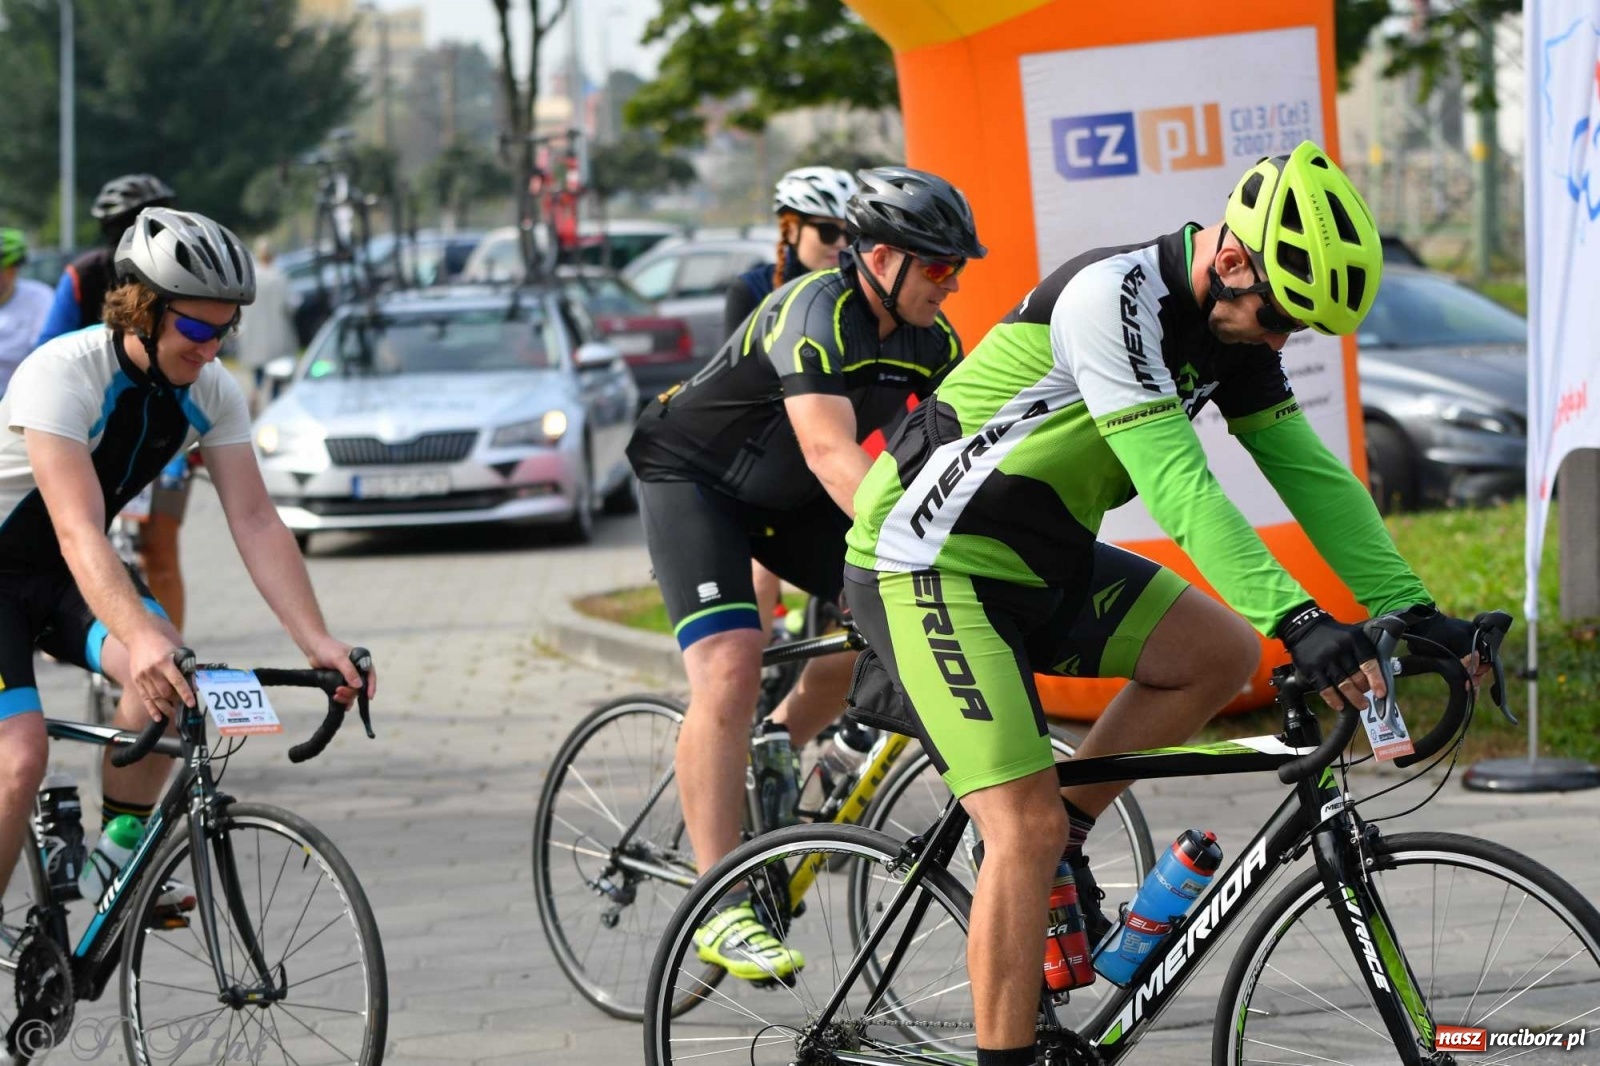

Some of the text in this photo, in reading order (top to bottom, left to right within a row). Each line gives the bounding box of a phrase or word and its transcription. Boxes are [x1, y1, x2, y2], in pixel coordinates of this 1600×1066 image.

[1064, 124, 1130, 168] CZ
[1120, 264, 1162, 394] MERIDA
[1106, 402, 1177, 429] MERIDA
[207, 689, 264, 711] 2097
[1135, 836, 1268, 1022] MERIDA
[1350, 916, 1392, 994] RACE
